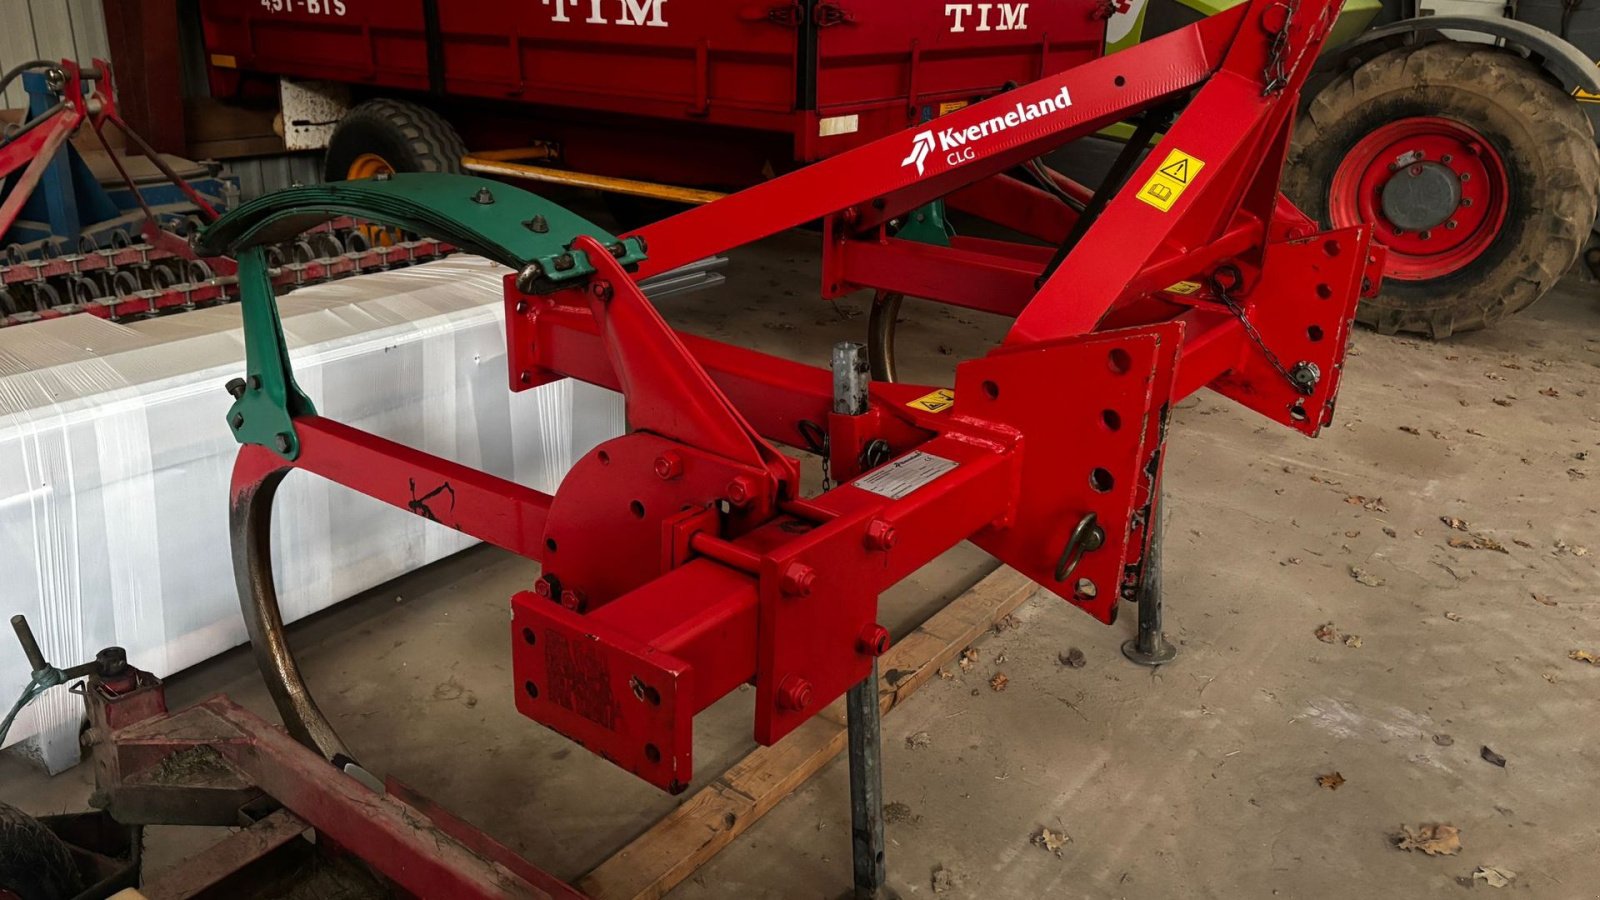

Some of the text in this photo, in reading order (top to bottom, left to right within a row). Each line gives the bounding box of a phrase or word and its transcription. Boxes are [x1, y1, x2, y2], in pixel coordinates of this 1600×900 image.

[542, 0, 669, 27] TIM
[945, 3, 1029, 32] TIM
[937, 86, 1073, 152] Kverneland
[946, 146, 976, 166] CLG
